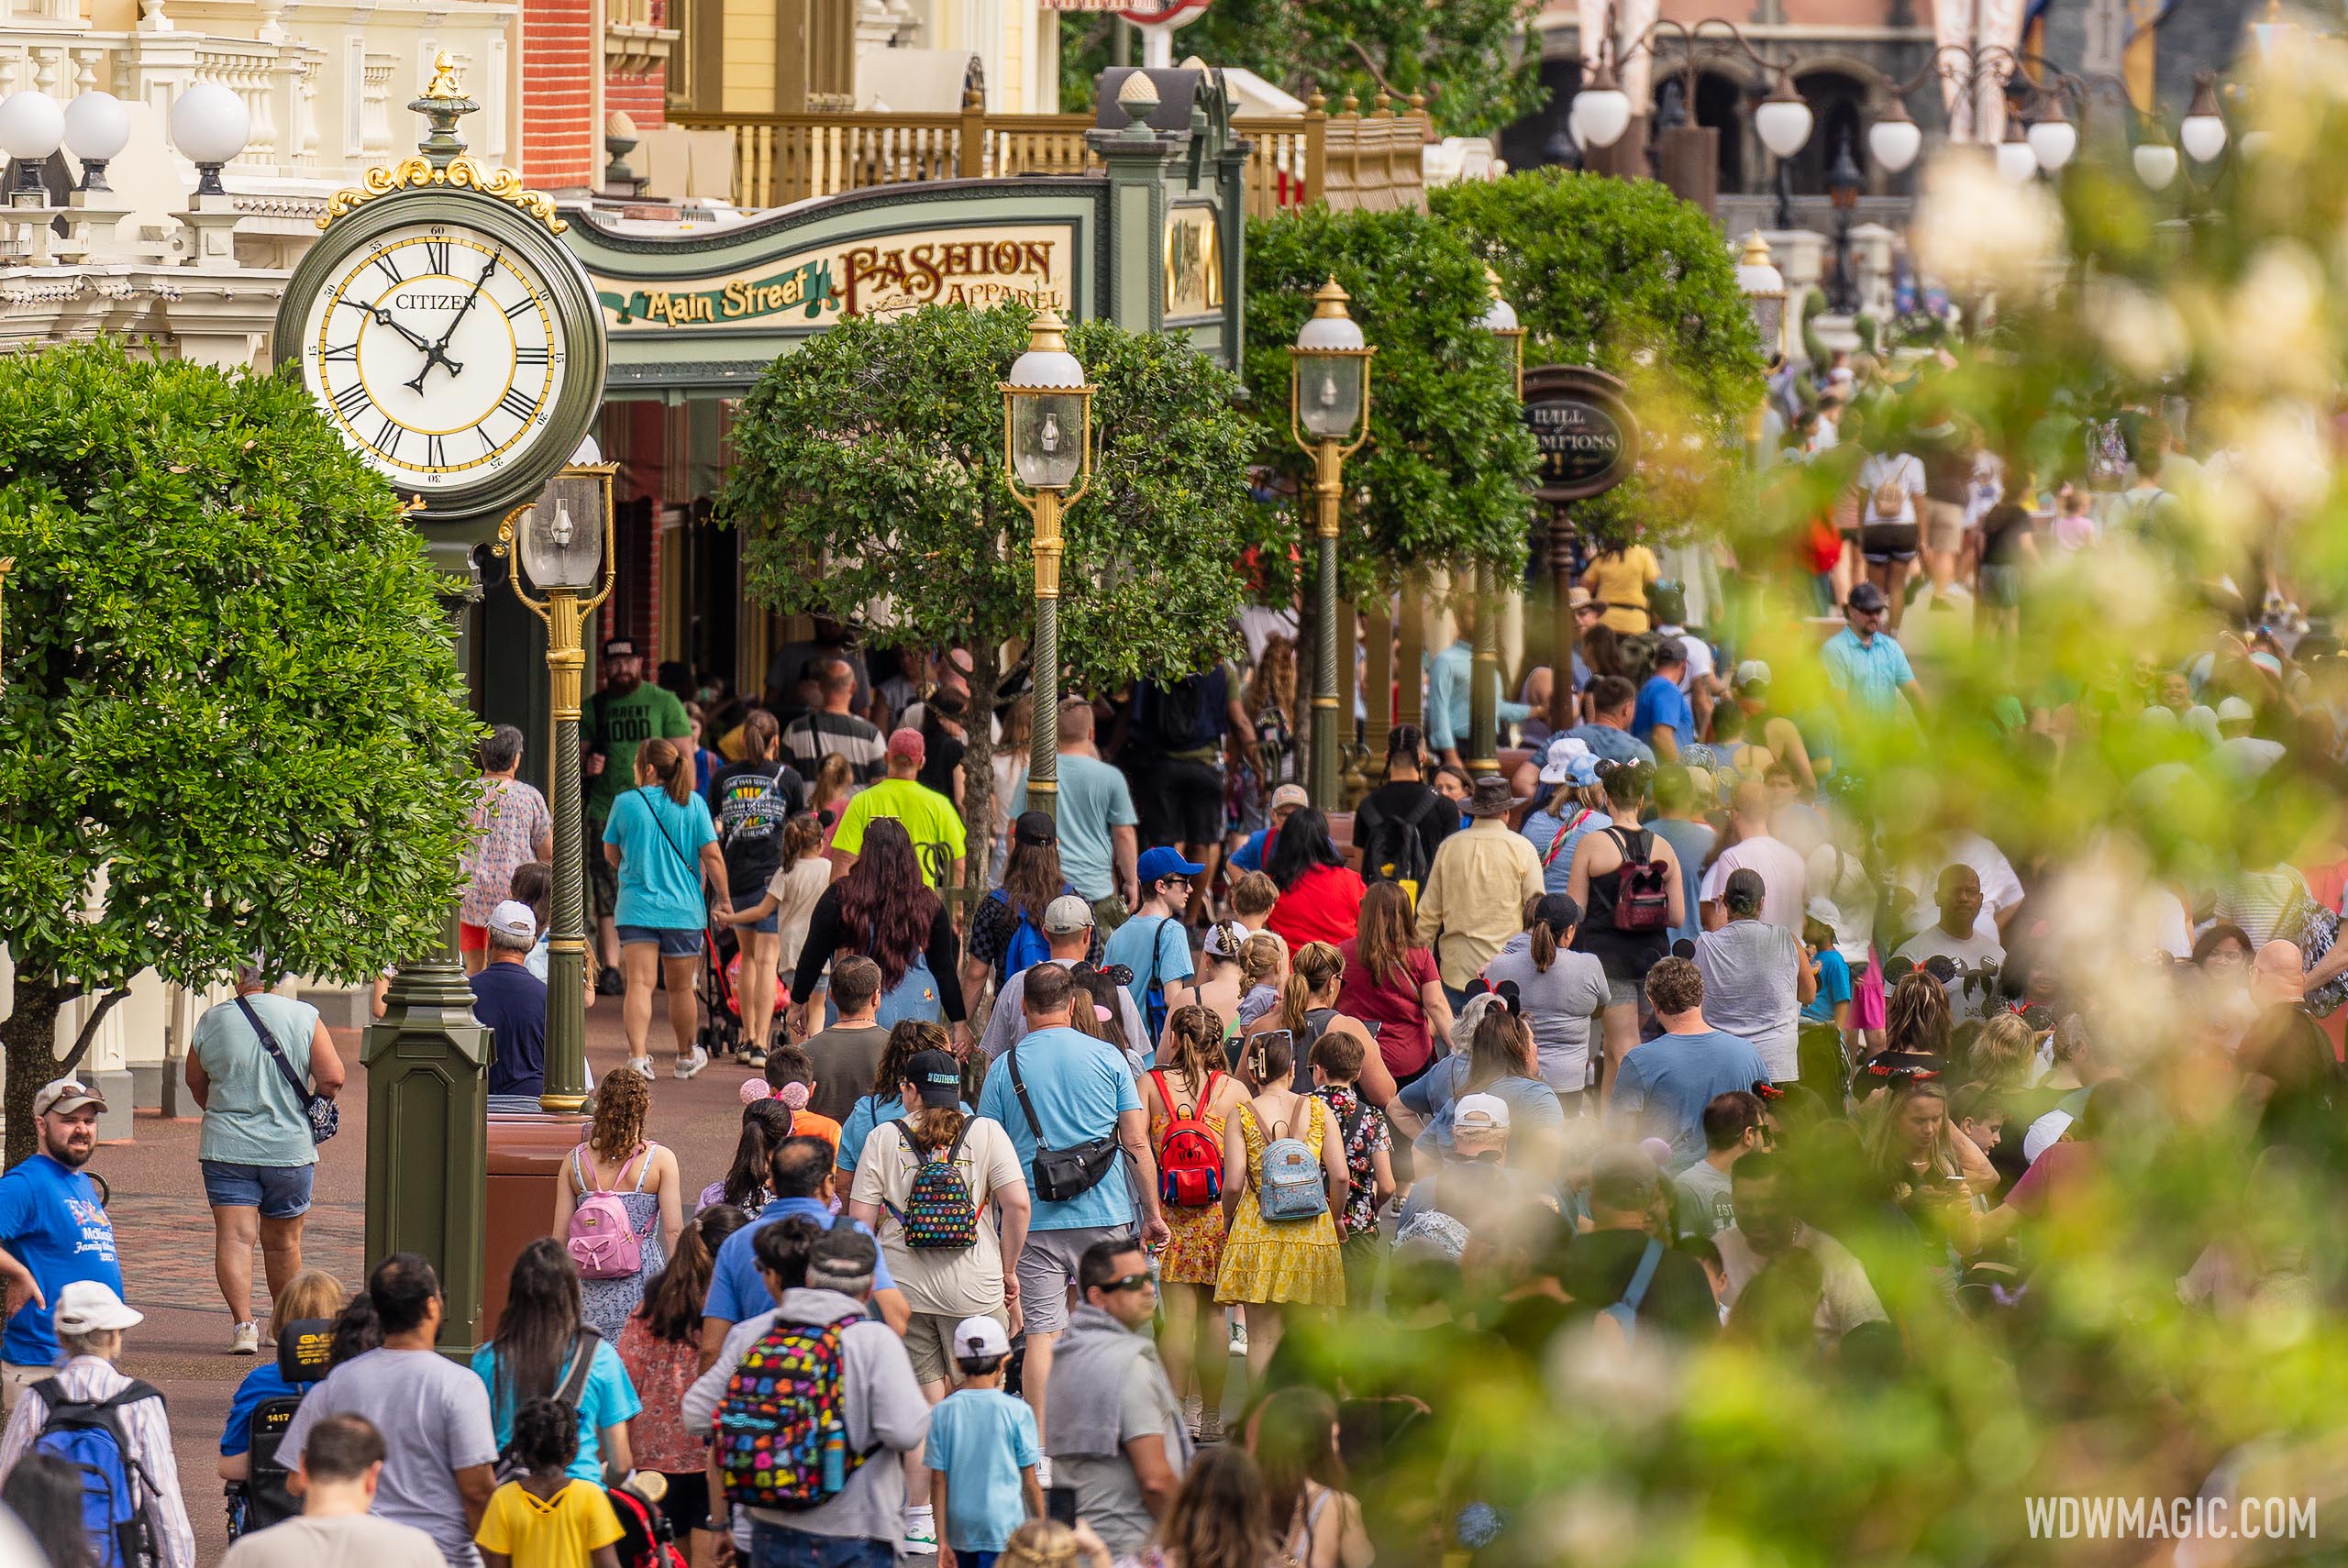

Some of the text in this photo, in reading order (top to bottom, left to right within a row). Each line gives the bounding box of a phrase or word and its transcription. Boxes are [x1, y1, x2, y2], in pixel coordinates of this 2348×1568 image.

[431, 226, 445, 236] 60
[369, 240, 383, 253] 55
[828, 240, 1056, 316] FASHION
[395, 293, 478, 311] CITIZEN
[643, 267, 809, 327] Main Street
[1540, 434, 1617, 449] MPIONS
[427, 474, 441, 483] 30
[605, 718, 651, 743] OOD
[267, 1413, 290, 1422] 1417
